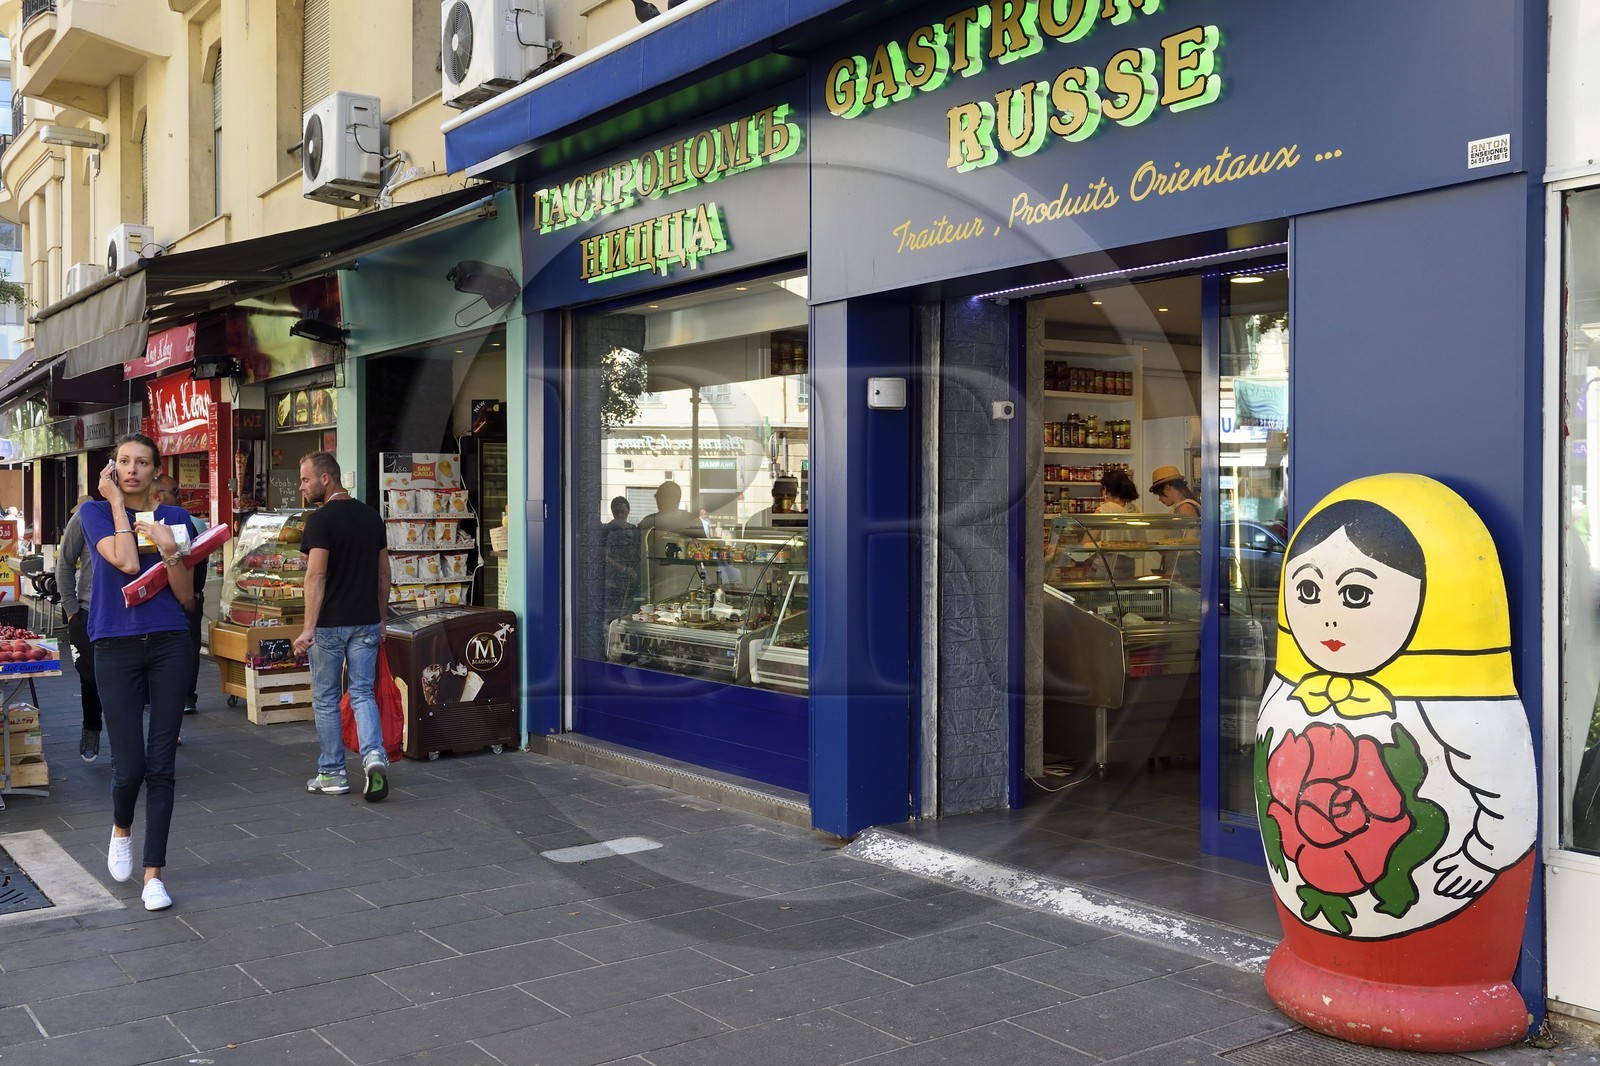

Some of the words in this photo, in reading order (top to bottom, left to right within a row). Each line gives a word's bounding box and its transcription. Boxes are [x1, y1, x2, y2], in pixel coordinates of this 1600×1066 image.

[946, 25, 1217, 172] RUSSE
[532, 104, 800, 233] ГАСТРОНОМЪ
[1471, 138, 1508, 153] ANTON
[1471, 147, 1508, 159] ENSEIGNES
[893, 215, 985, 254] Traiteur
[1008, 177, 1119, 229] Produits
[1129, 143, 1301, 202] Orientaux
[579, 203, 727, 283] НИЦЦА
[270, 477, 292, 487] Kebab
[472, 657, 498, 665] MAGNUM
